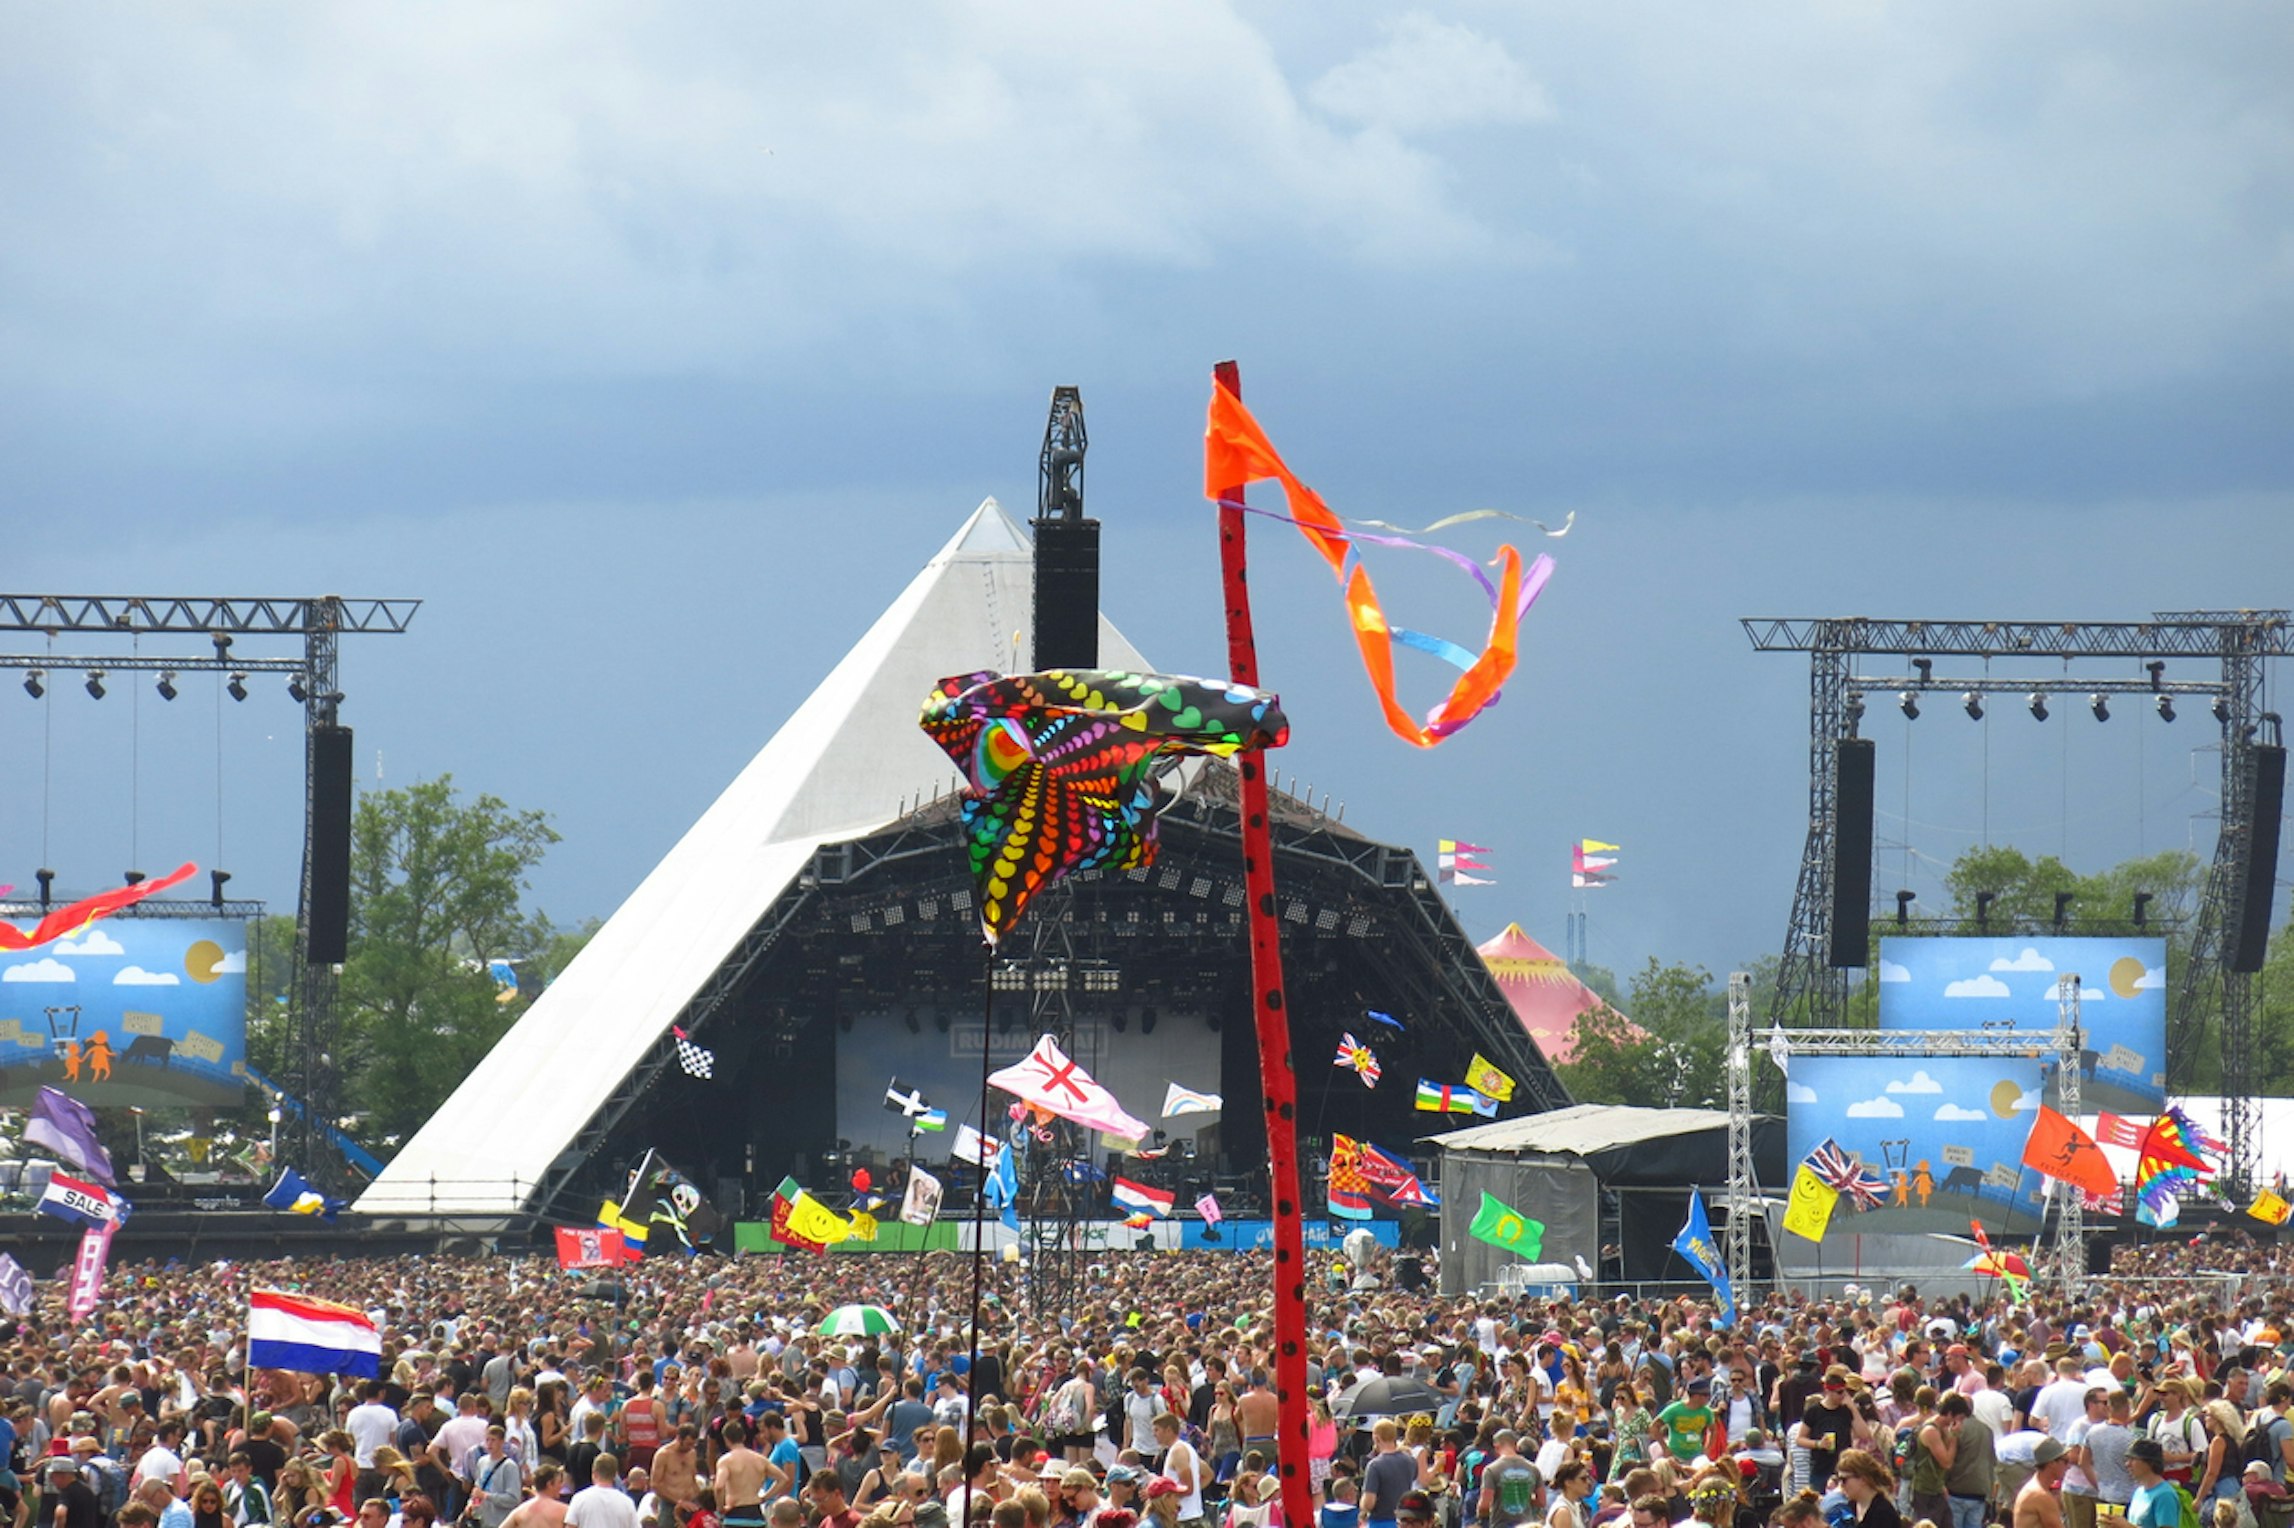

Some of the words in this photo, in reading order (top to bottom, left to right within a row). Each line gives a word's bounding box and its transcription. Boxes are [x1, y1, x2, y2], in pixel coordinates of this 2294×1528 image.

[958, 1031, 1096, 1049] RUDIMAL
[64, 1190, 105, 1216] SALE
[1264, 1227, 1330, 1242] WrAid
